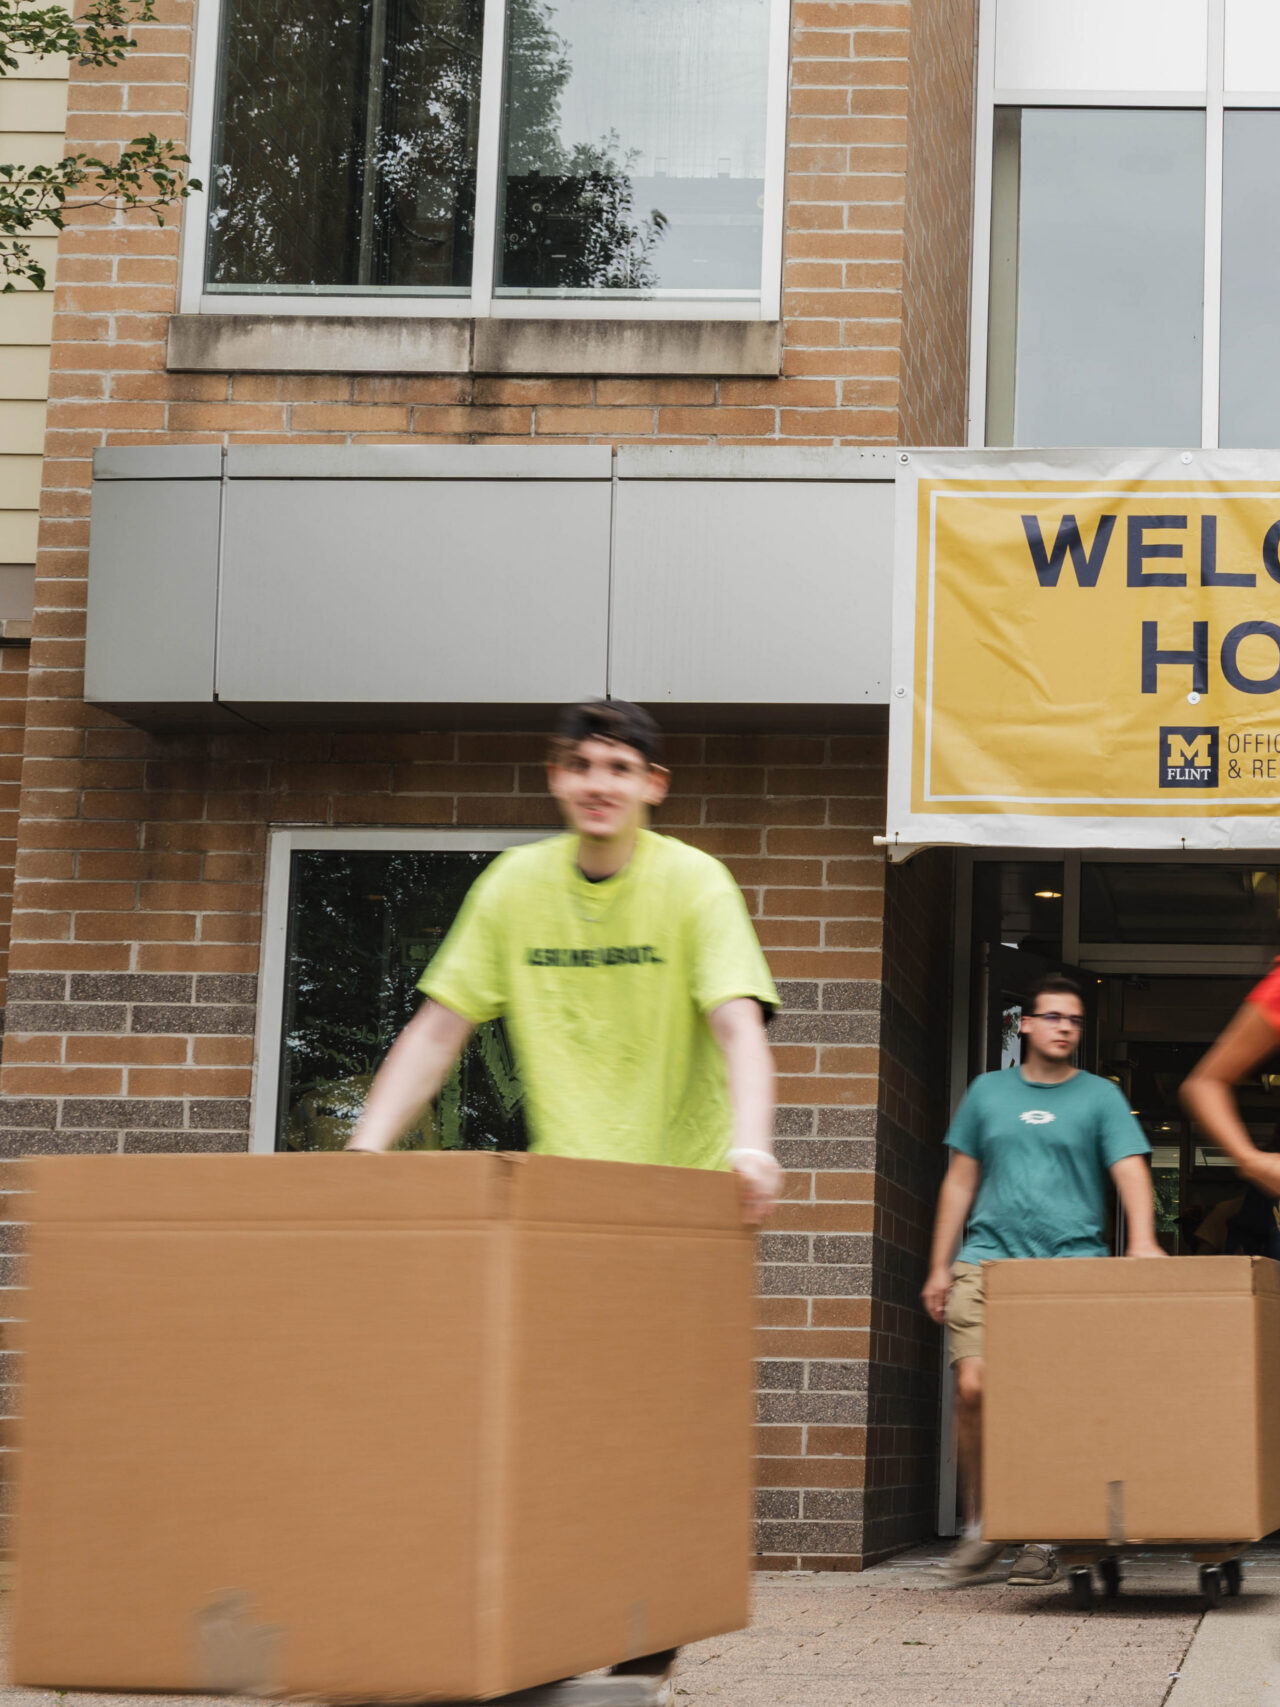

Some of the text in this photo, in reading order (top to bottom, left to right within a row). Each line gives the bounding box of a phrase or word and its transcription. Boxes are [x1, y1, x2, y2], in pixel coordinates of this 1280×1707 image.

[1167, 734, 1211, 766] M
[1167, 768, 1211, 780] FLINT
[1228, 759, 1242, 779] &
